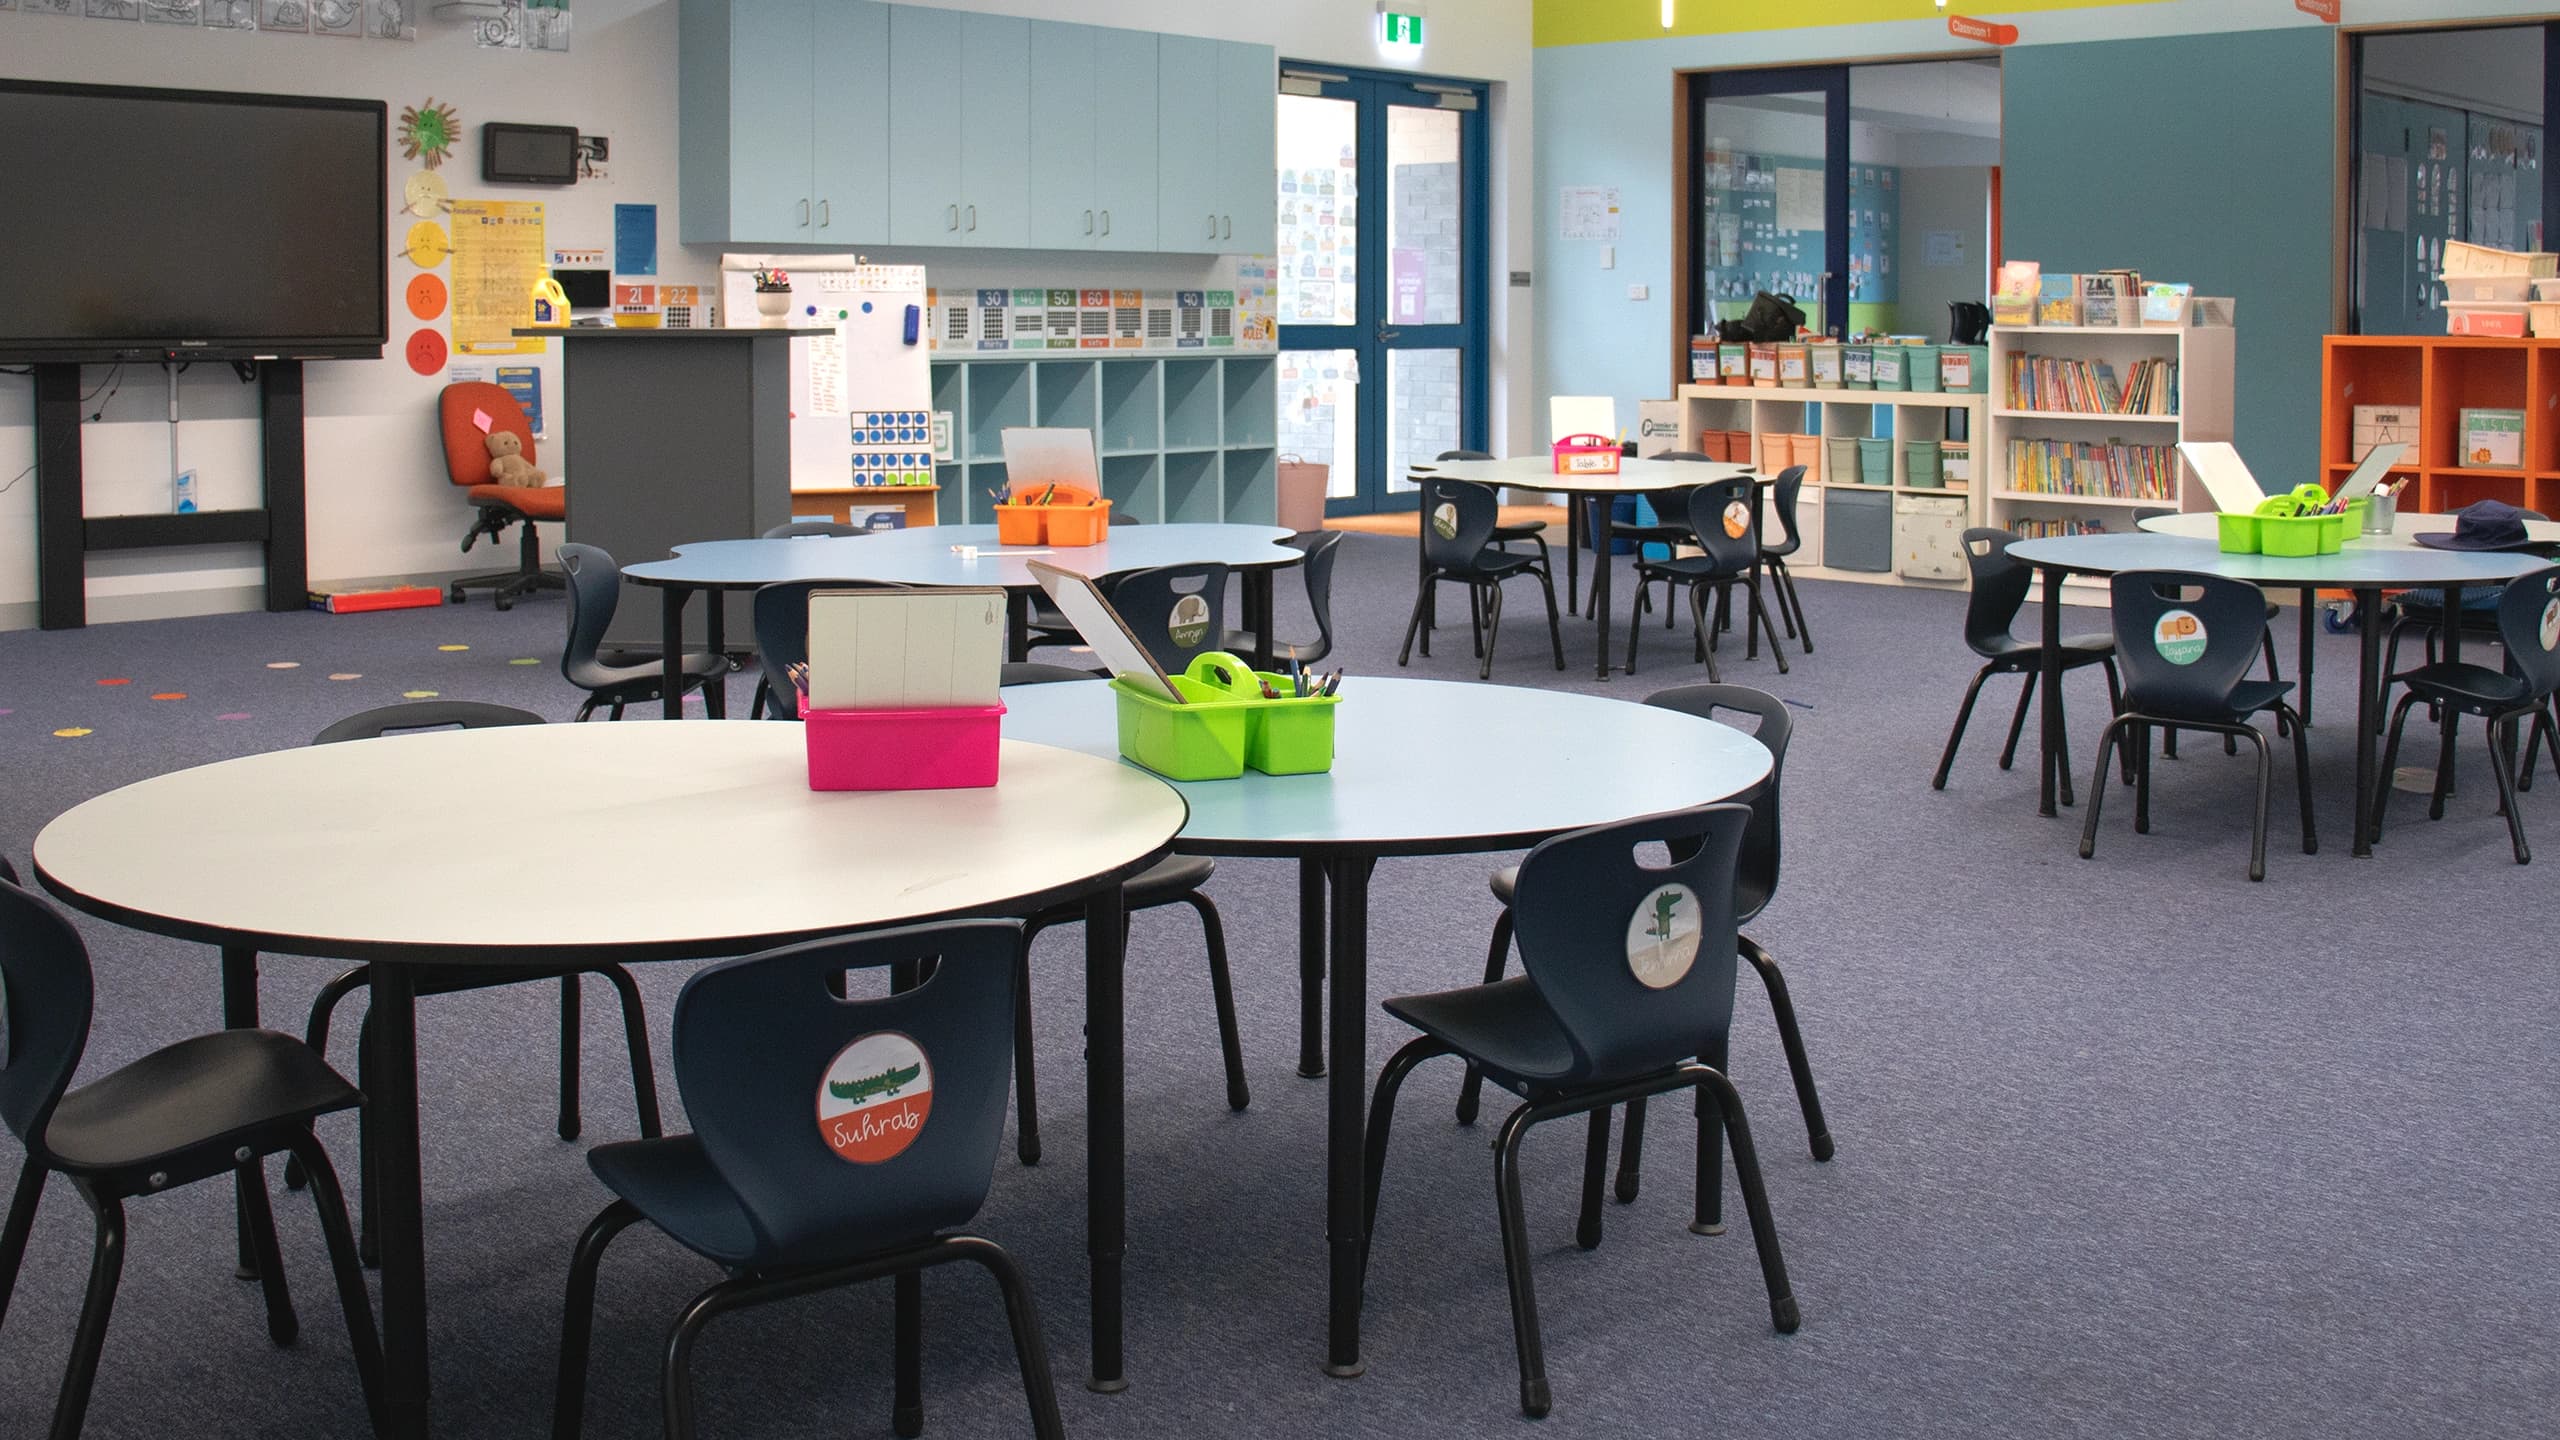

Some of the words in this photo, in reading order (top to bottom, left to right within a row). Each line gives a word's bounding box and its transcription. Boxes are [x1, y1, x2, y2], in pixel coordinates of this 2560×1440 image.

[1952, 18, 1987, 38] Classroom
[2086, 278, 2113, 290] ZAC
[629, 287, 642, 304] 21
[671, 288, 688, 304] 22
[985, 291, 1001, 305] 30
[1054, 291, 1069, 305] 50
[1088, 291, 1103, 305] 60
[1121, 292, 1135, 305] 70
[1183, 293, 1198, 306] 90
[1211, 293, 1229, 306] 100
[1602, 456, 1610, 467] 5
[833, 1101, 921, 1149] Suhrab
